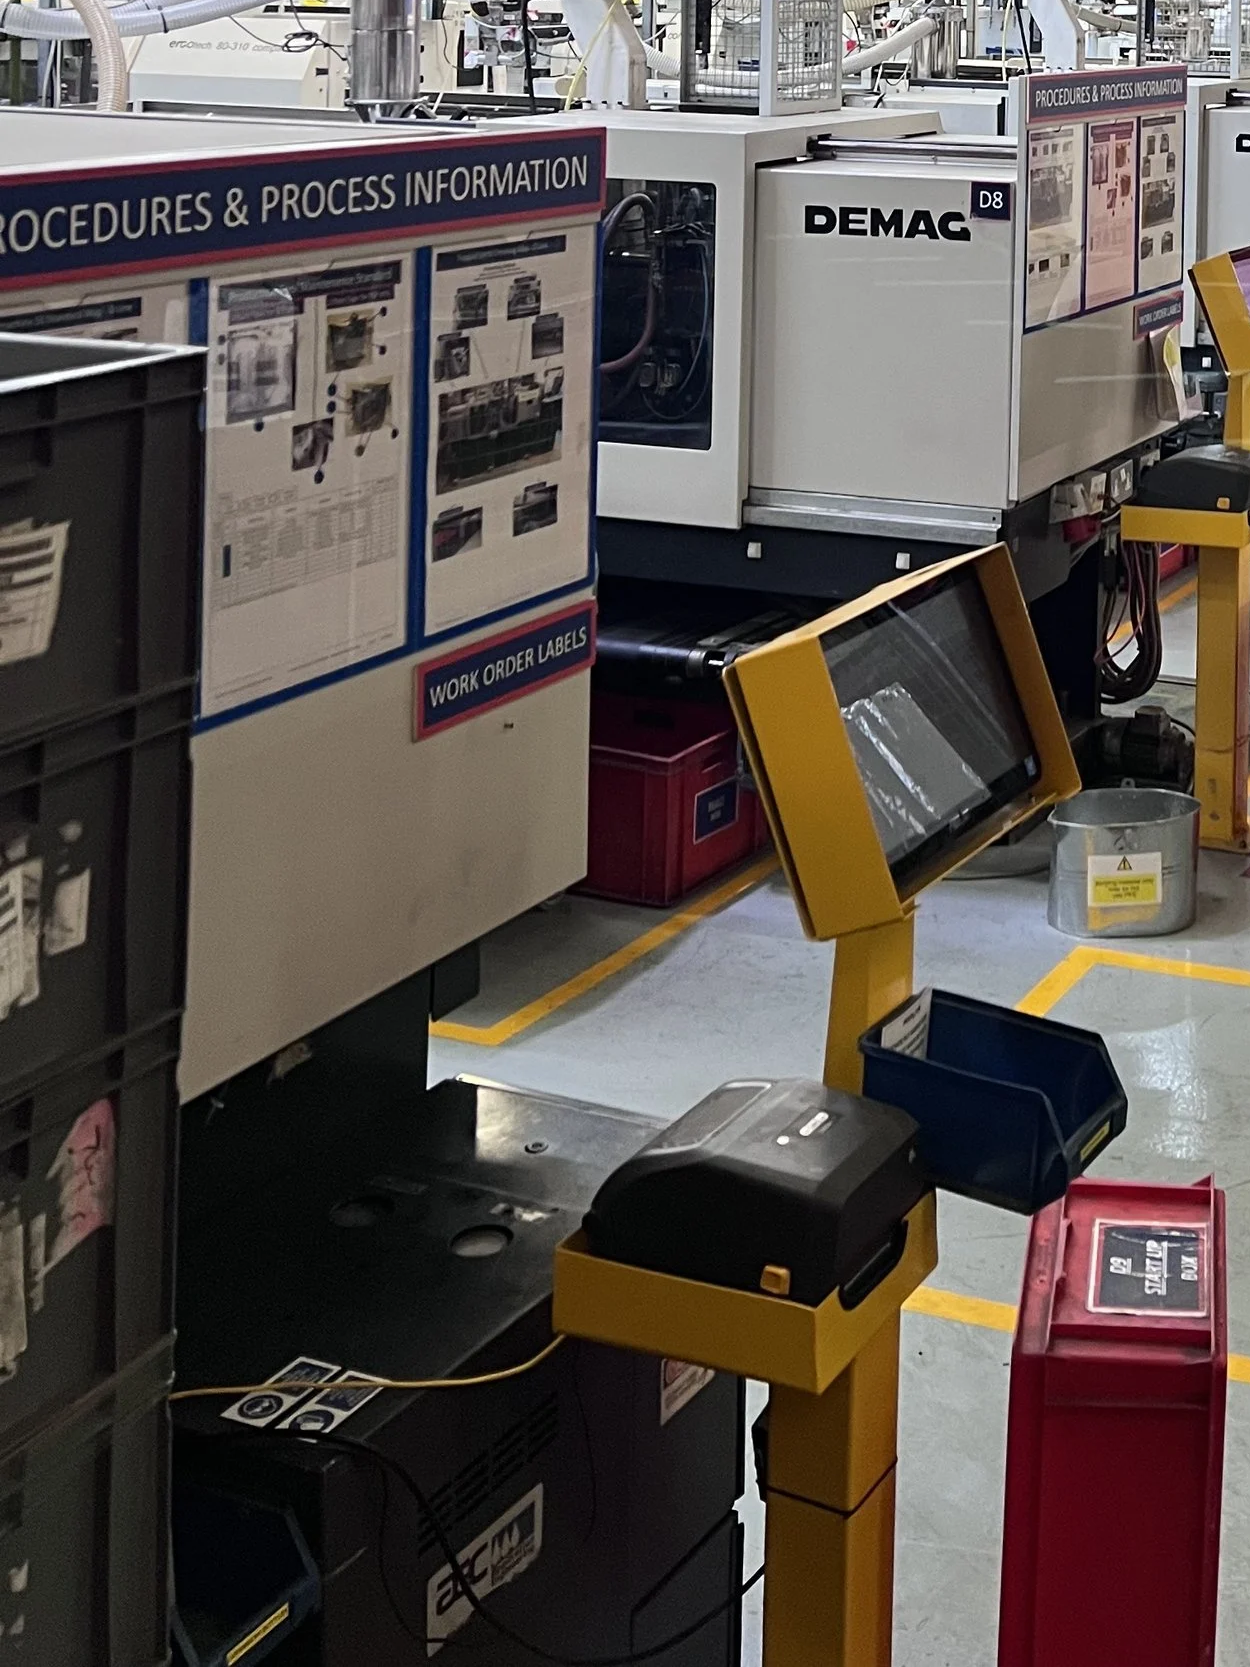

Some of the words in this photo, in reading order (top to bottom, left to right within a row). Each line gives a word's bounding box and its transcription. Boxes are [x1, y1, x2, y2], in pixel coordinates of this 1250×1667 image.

[1035, 86, 1090, 108] PROCEDURES
[1092, 84, 1098, 102] &
[1100, 82, 1134, 102] PROCESS
[1134, 78, 1183, 98] INFORMATION
[0, 191, 213, 254] OCEDURES
[223, 187, 249, 228] &
[261, 174, 397, 223] PROCESS
[405, 154, 588, 207] INFORMATION
[979, 190, 1004, 209] D8
[805, 205, 971, 242] DEMAG
[429, 669, 480, 708] WORK
[483, 648, 536, 685] ORDER
[538, 626, 588, 664] LABELS
[1145, 1240, 1163, 1258] UP
[1144, 1258, 1163, 1295] START
[1180, 1254, 1198, 1281] BOX
